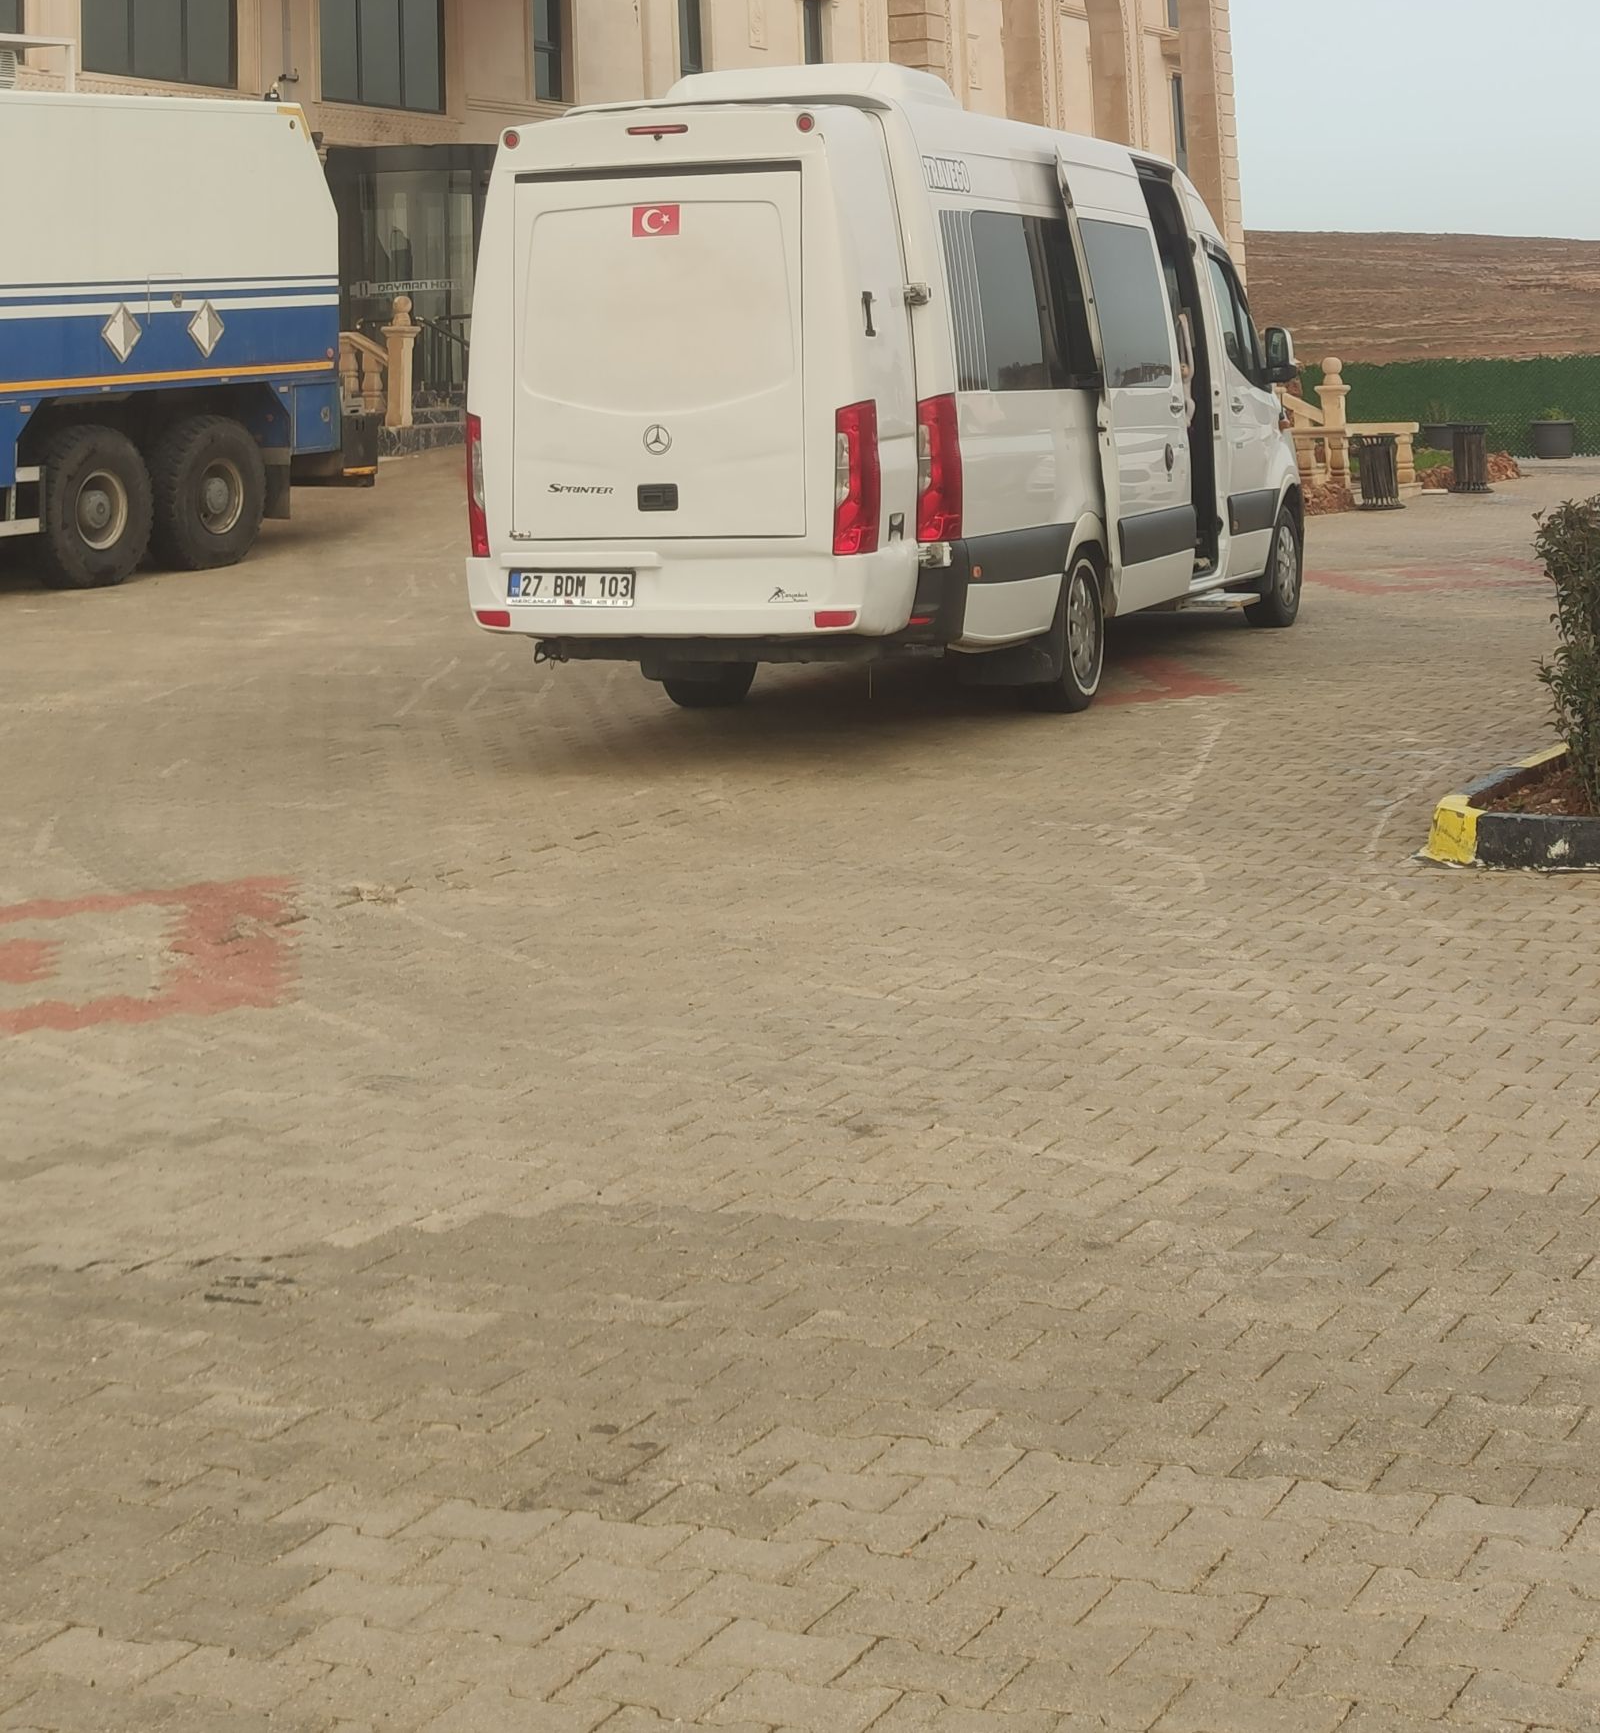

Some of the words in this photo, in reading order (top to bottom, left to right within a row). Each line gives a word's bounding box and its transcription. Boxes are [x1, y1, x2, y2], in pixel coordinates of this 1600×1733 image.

[921, 155, 971, 194] TRAVEGO
[377, 281, 428, 292] DAYMAN
[521, 575, 543, 597] 27
[553, 575, 586, 597] BDM
[599, 575, 630, 598] 103
